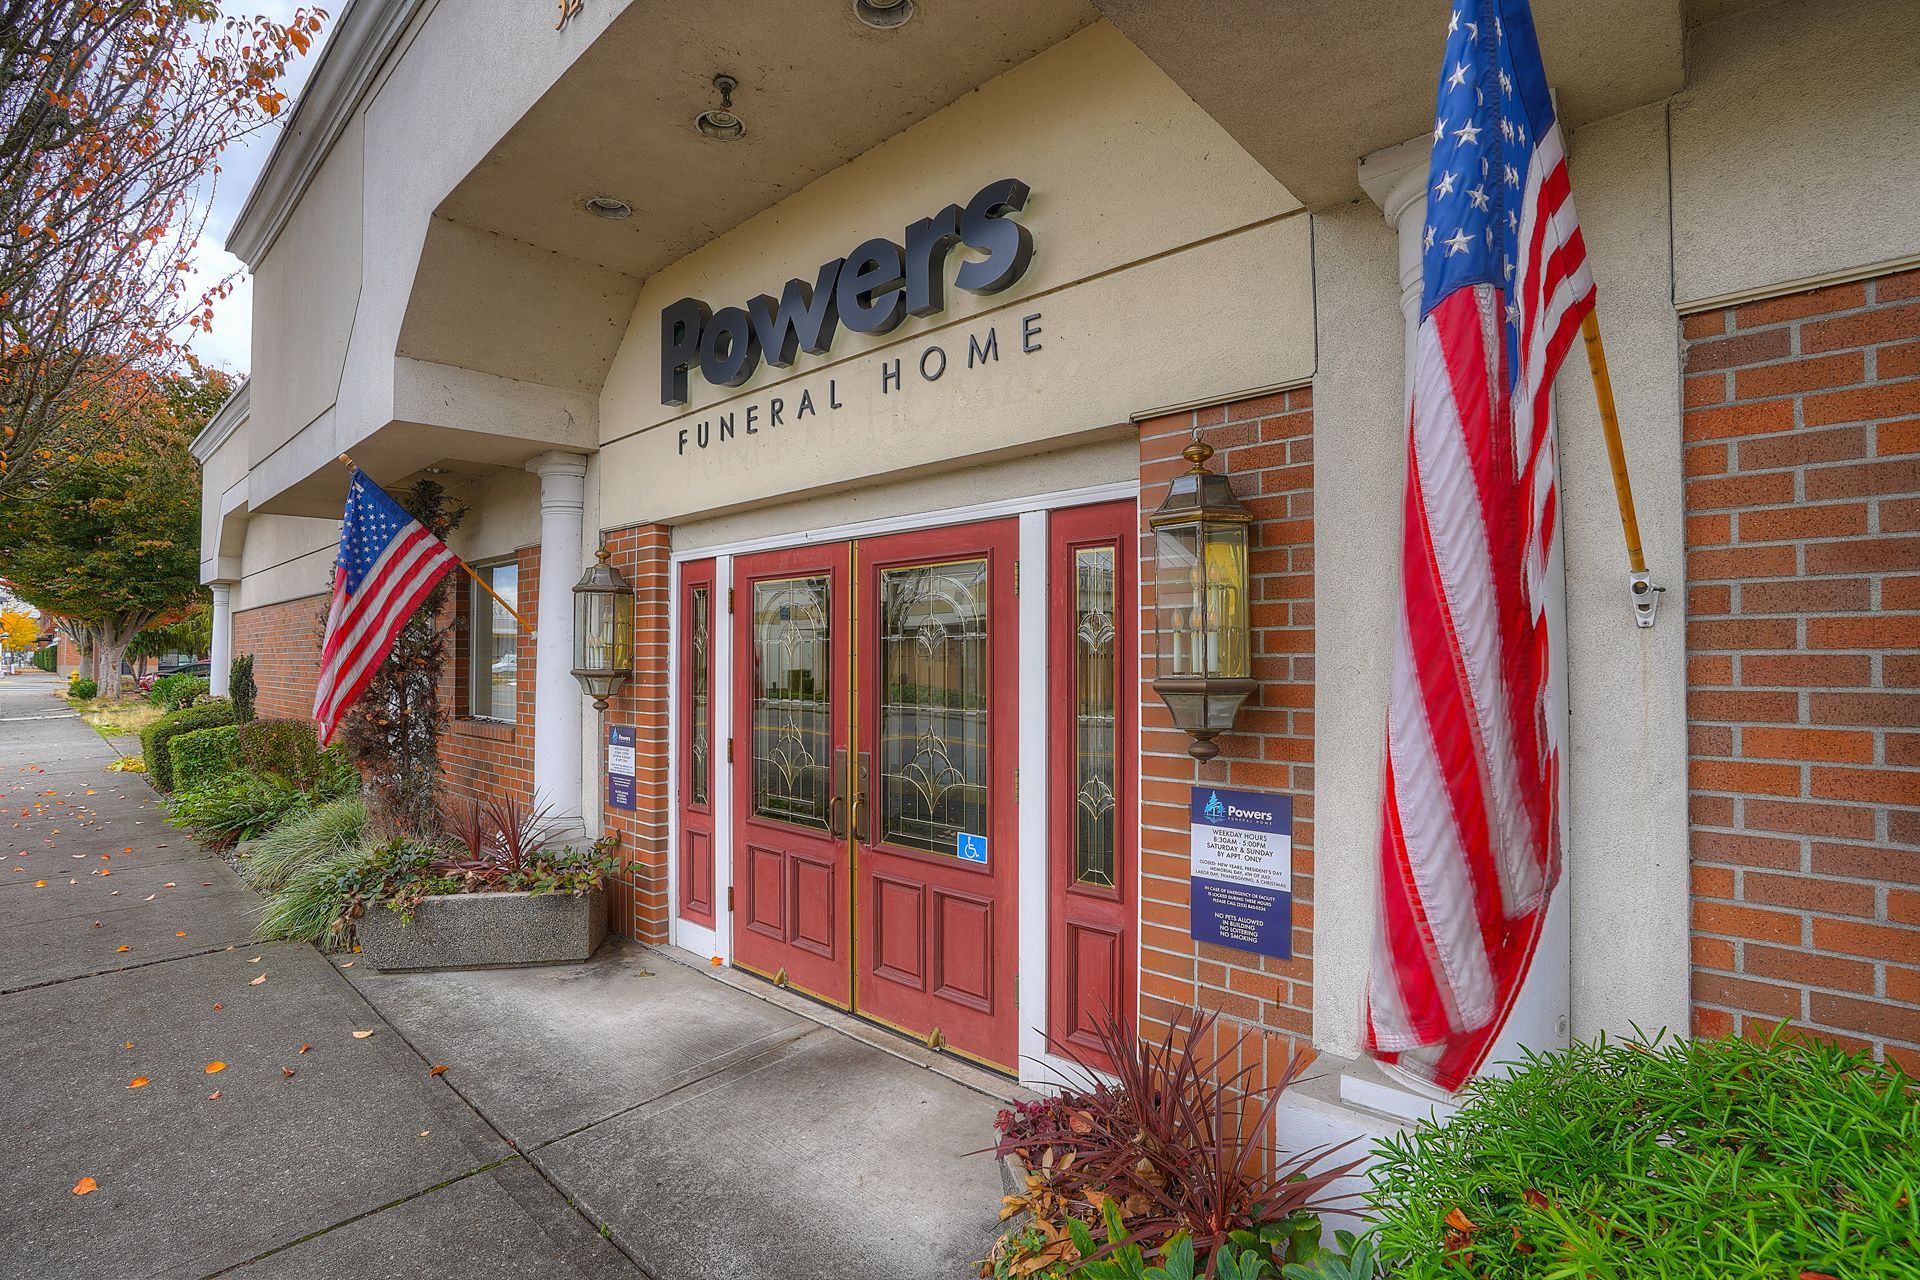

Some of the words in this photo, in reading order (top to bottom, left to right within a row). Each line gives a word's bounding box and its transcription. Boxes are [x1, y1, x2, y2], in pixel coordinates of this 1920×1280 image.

[660, 177, 1034, 407] Powers
[678, 379, 843, 455] FUNERAL
[881, 312, 1042, 395] HOME
[1228, 806, 1272, 820] Powers
[1212, 829, 1242, 838] WEEKDAY
[1244, 833, 1267, 841] HOURS
[1214, 836, 1237, 845] 8:30AM
[1207, 842, 1238, 851] SATURDAY
[1247, 848, 1273, 857] SUNDAY
[1220, 873, 1254, 883] THANKSGIVING,
[1230, 921, 1255, 930] BUILDING
[1238, 917, 1263, 926] ALLOWED
[1230, 927, 1258, 937] LOITERING
[1231, 933, 1257, 943] SMOKING
